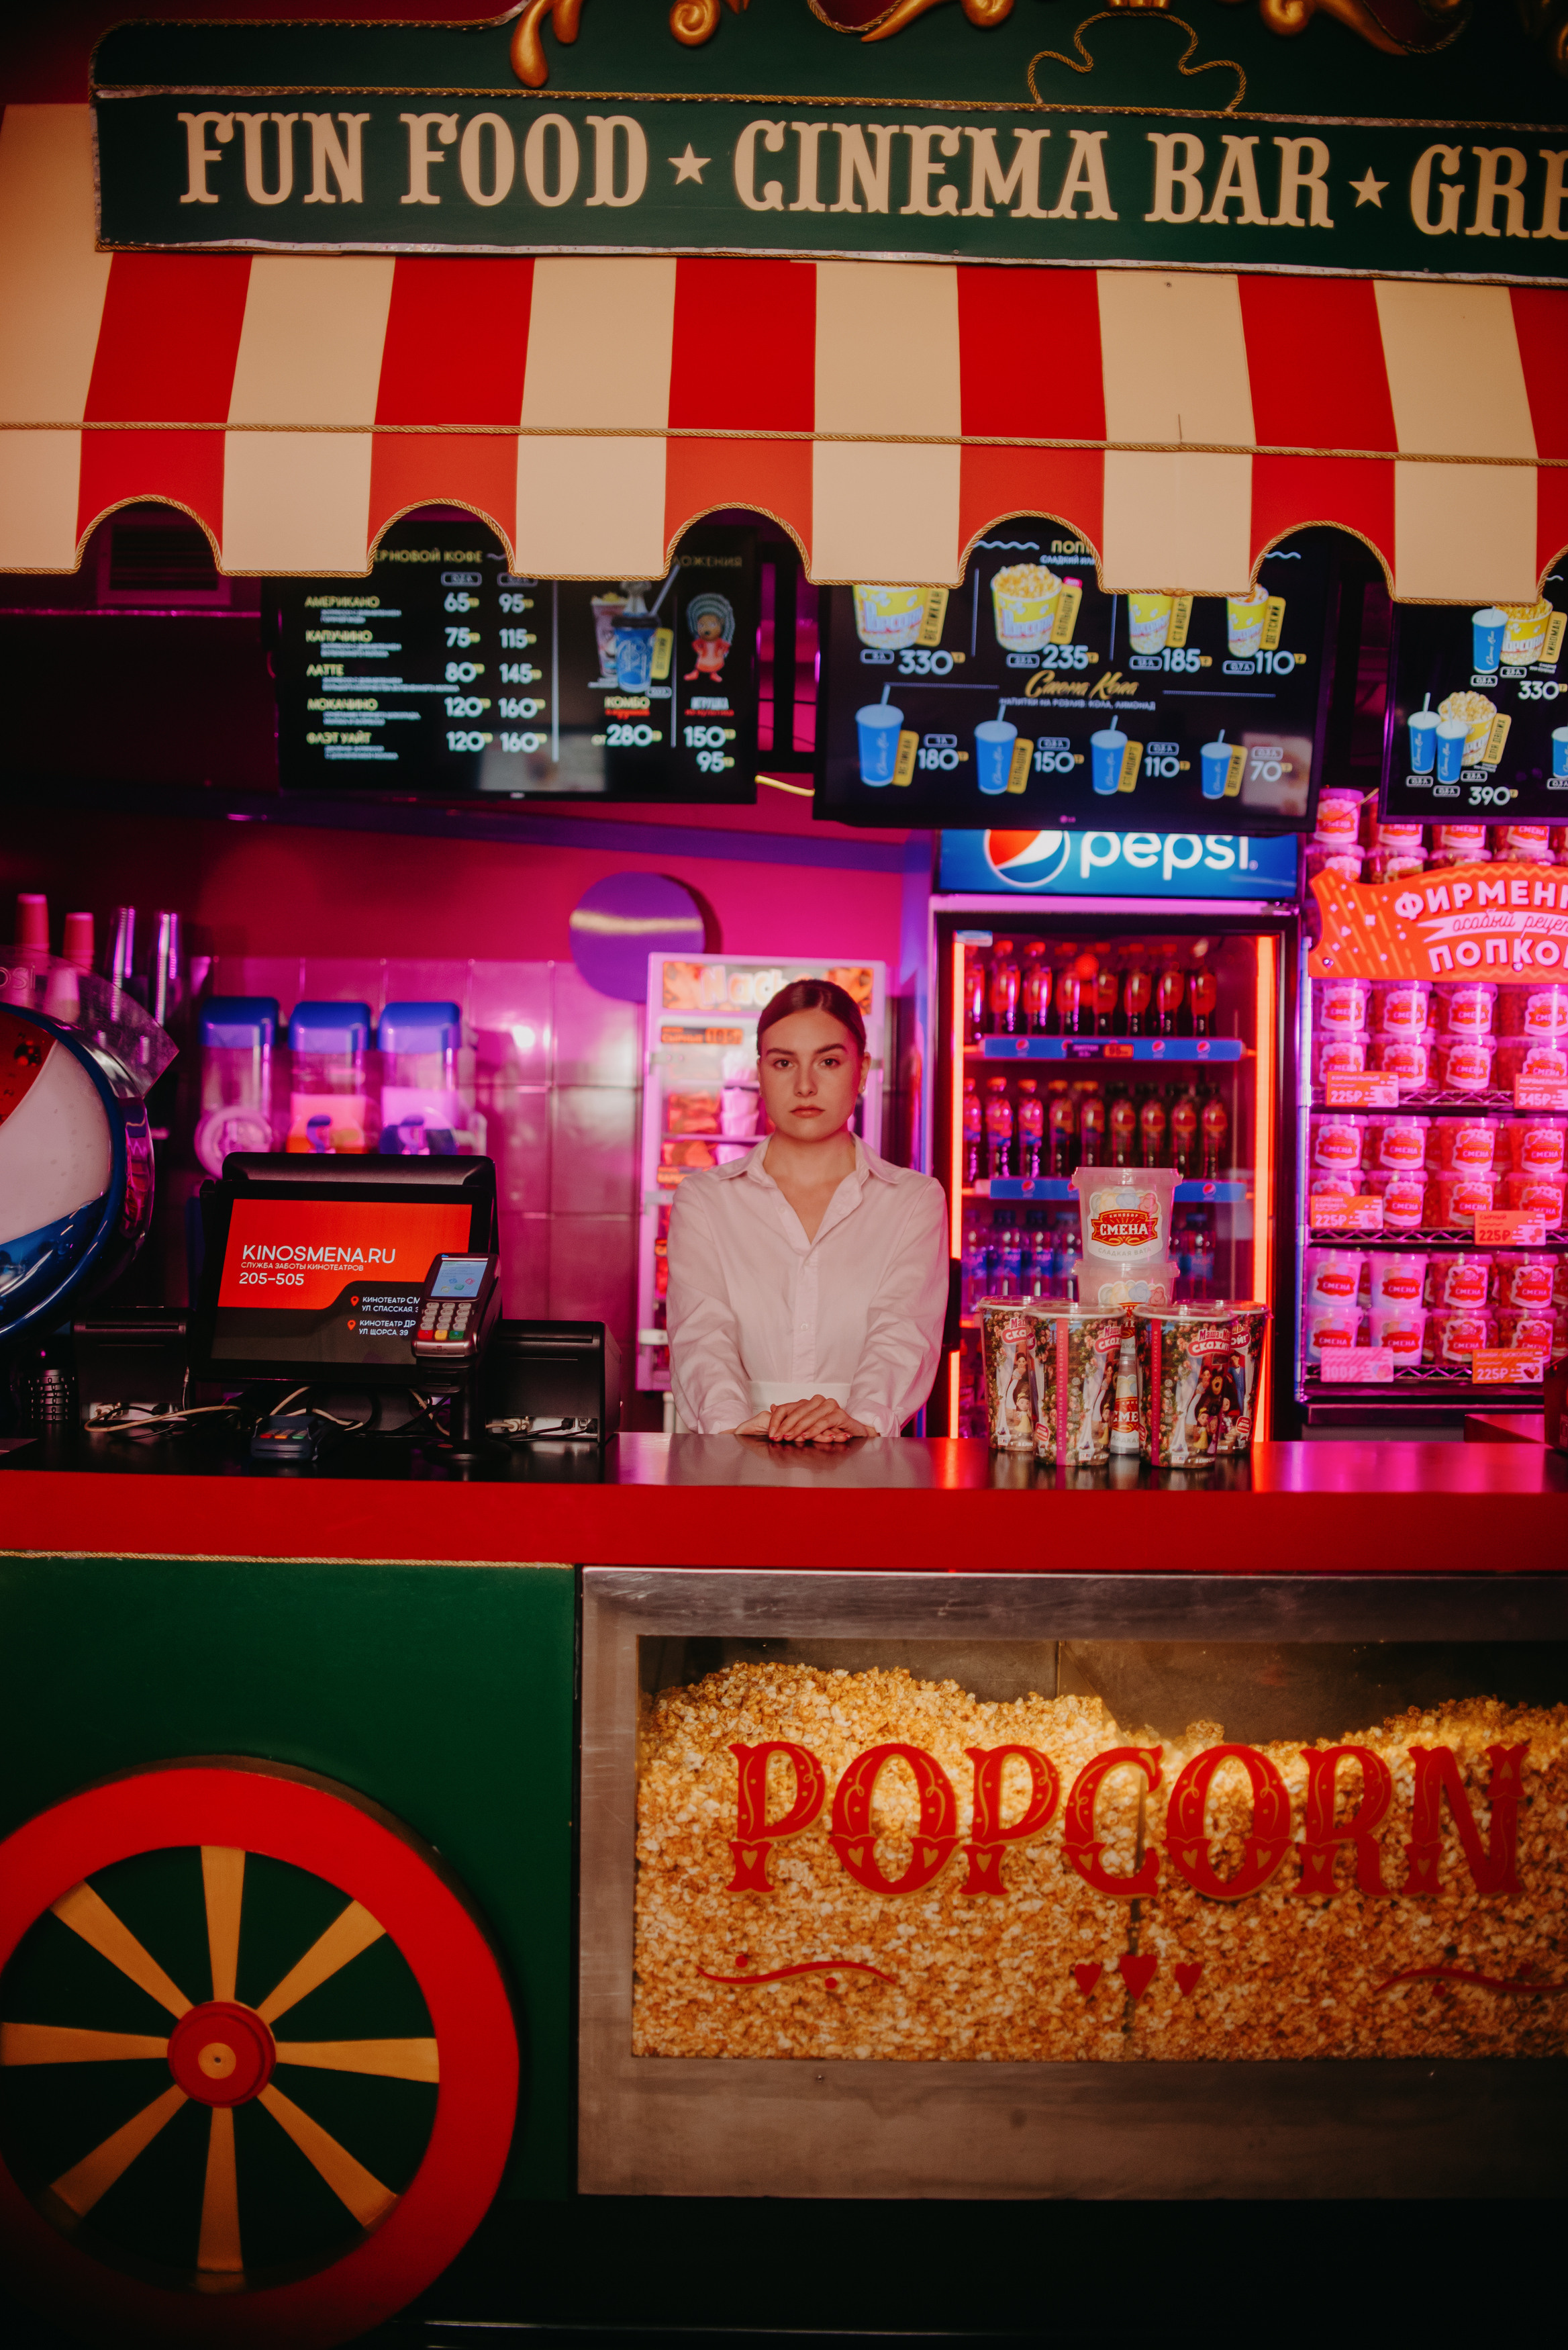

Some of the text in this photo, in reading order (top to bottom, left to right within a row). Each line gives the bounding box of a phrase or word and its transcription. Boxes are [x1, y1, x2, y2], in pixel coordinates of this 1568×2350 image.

[178, 111, 370, 205] FUN
[400, 112, 648, 207] FOOD
[735, 120, 1118, 222] CINEMA
[1144, 132, 1334, 230] BAR
[444, 592, 470, 612] 65
[499, 593, 525, 613] 95
[444, 627, 471, 648] 75
[499, 628, 528, 649] 115
[897, 649, 954, 675] 330
[1041, 644, 1089, 670] 235
[1162, 647, 1201, 673] 185
[1255, 650, 1295, 675] 110
[445, 661, 477, 683] 80
[499, 663, 532, 684] 145
[1518, 681, 1559, 700] 330
[444, 696, 483, 717] 120
[499, 698, 538, 718] 160
[446, 731, 485, 751] 120
[500, 732, 539, 752] 160
[607, 724, 653, 747] 280
[683, 726, 726, 748] 150
[696, 751, 726, 772] 95
[918, 749, 959, 770] 180
[1034, 751, 1075, 773] 150
[1144, 756, 1180, 778] 110
[1251, 760, 1283, 782] 70
[1469, 786, 1510, 806] 390
[1428, 939, 1568, 973] ПОПКО
[1099, 1223, 1148, 1236] СМЕНА
[242, 1245, 395, 1264] KINOSMENA.RU
[1098, 1248, 1132, 1256] СЛАДКАЯ
[239, 1272, 304, 1285] 205-505
[726, 1740, 1530, 1901] POPCORN
